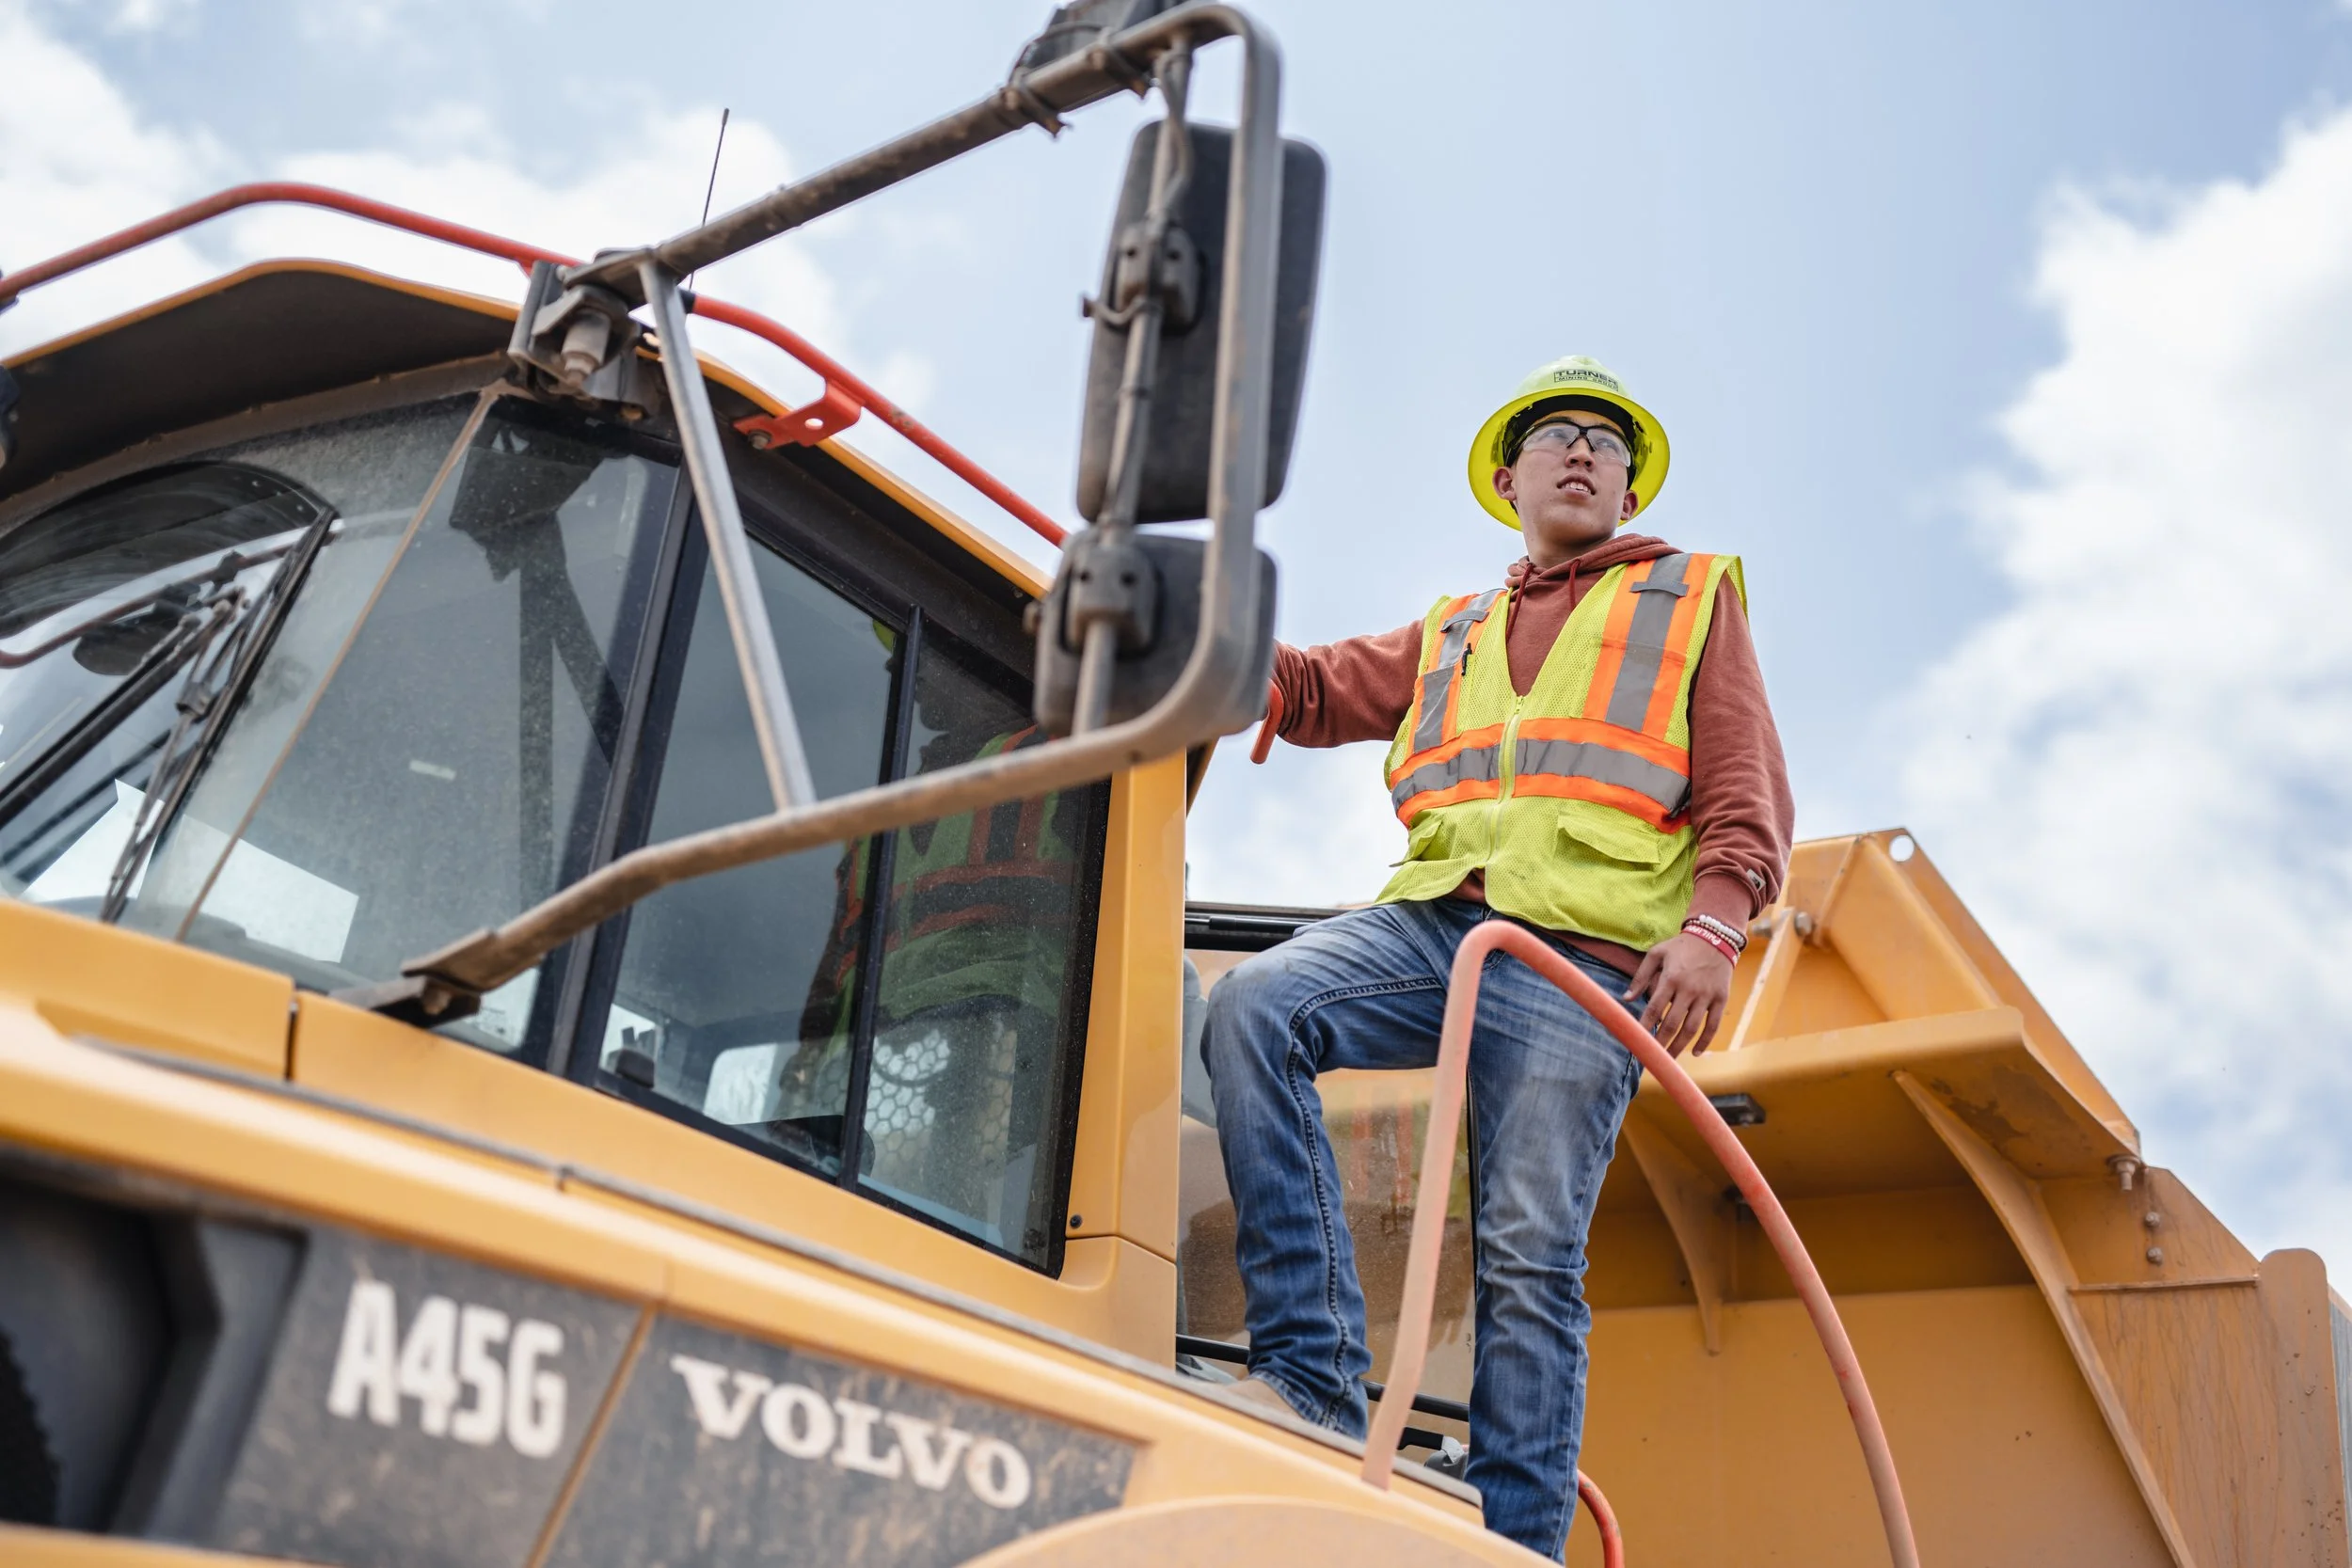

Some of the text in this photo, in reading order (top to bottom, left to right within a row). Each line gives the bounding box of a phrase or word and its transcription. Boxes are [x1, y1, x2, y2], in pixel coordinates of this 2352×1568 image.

[1556, 370, 1616, 385] TURNER
[327, 1278, 566, 1459] A45G
[670, 1354, 1031, 1509] VOLVO
